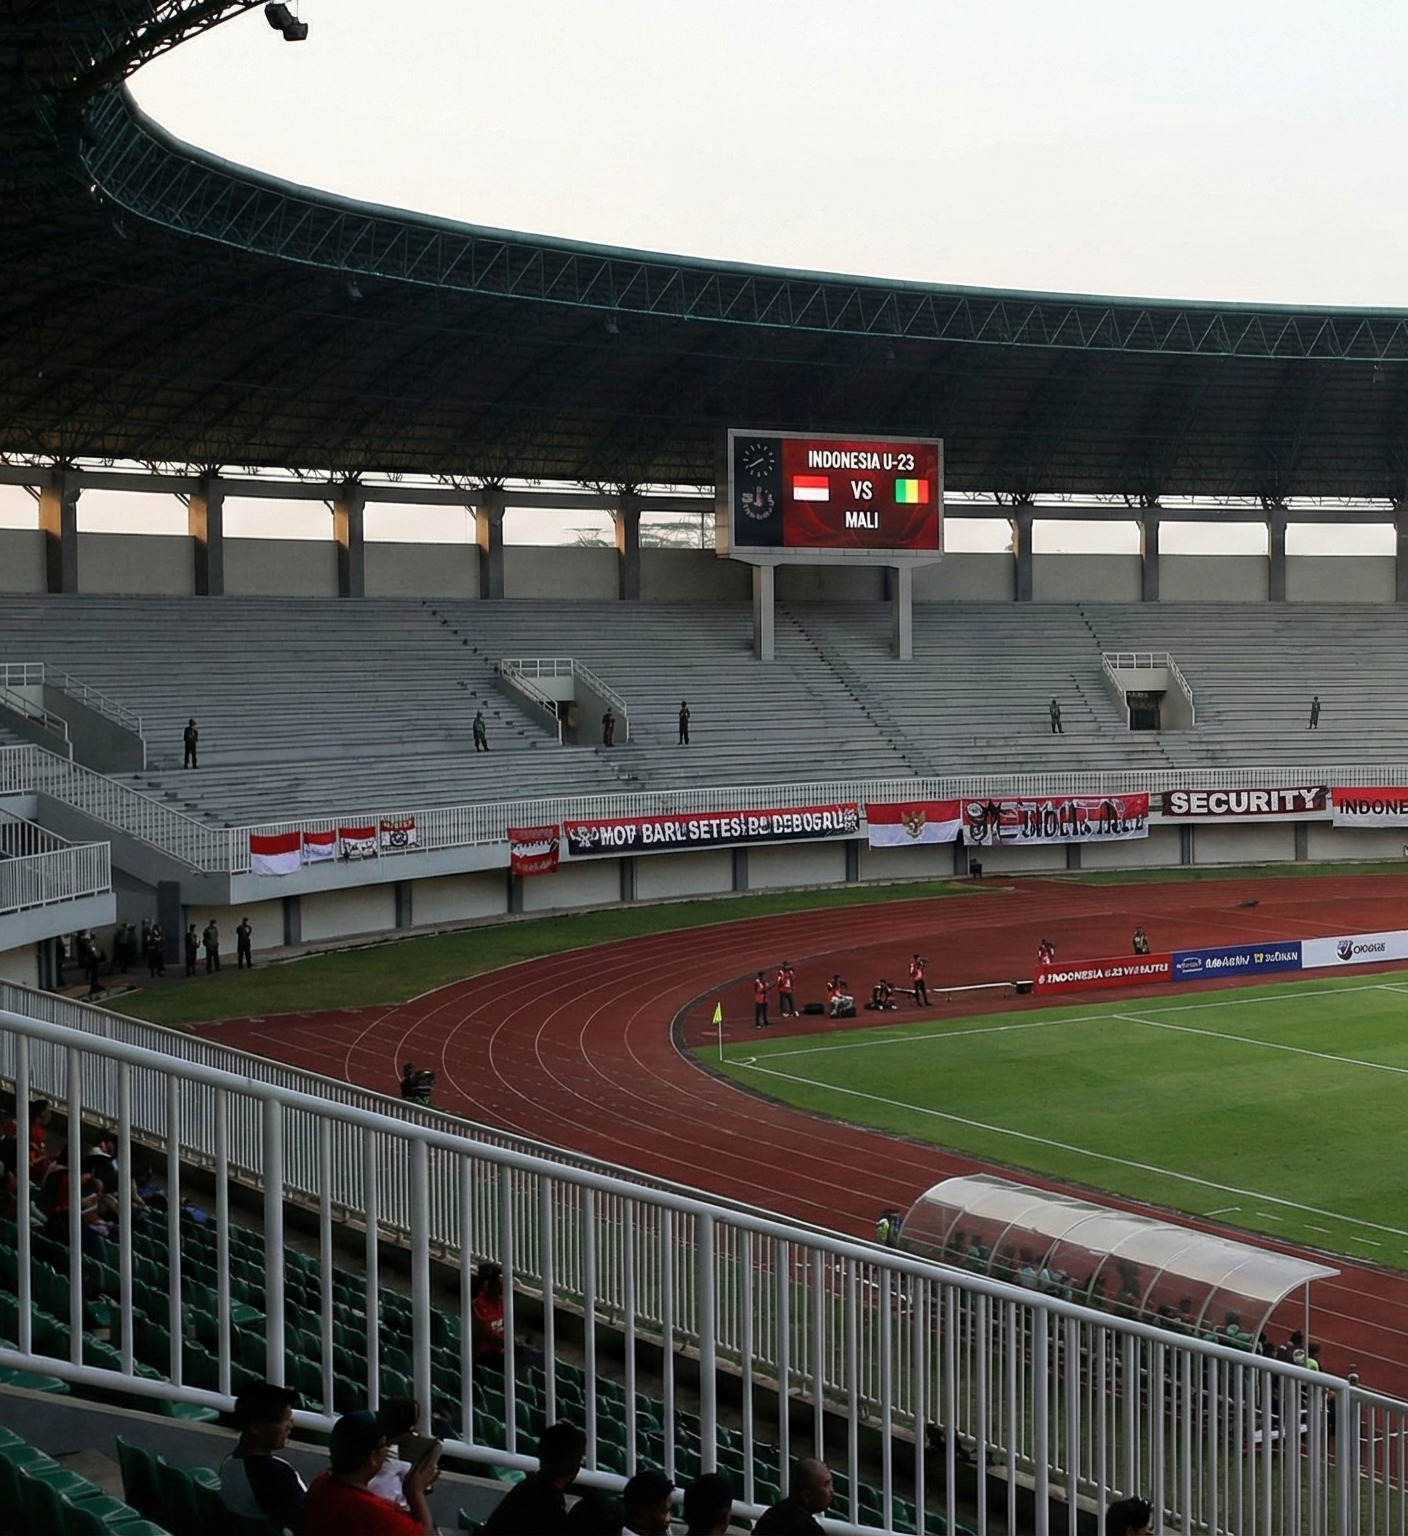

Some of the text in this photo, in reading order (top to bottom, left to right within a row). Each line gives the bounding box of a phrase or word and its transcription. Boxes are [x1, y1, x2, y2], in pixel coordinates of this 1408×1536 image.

[808, 450, 915, 471] INDONESIA U-23
[850, 480, 873, 500] VS
[845, 511, 879, 529] MALI
[1170, 787, 1320, 814] SECURITY
